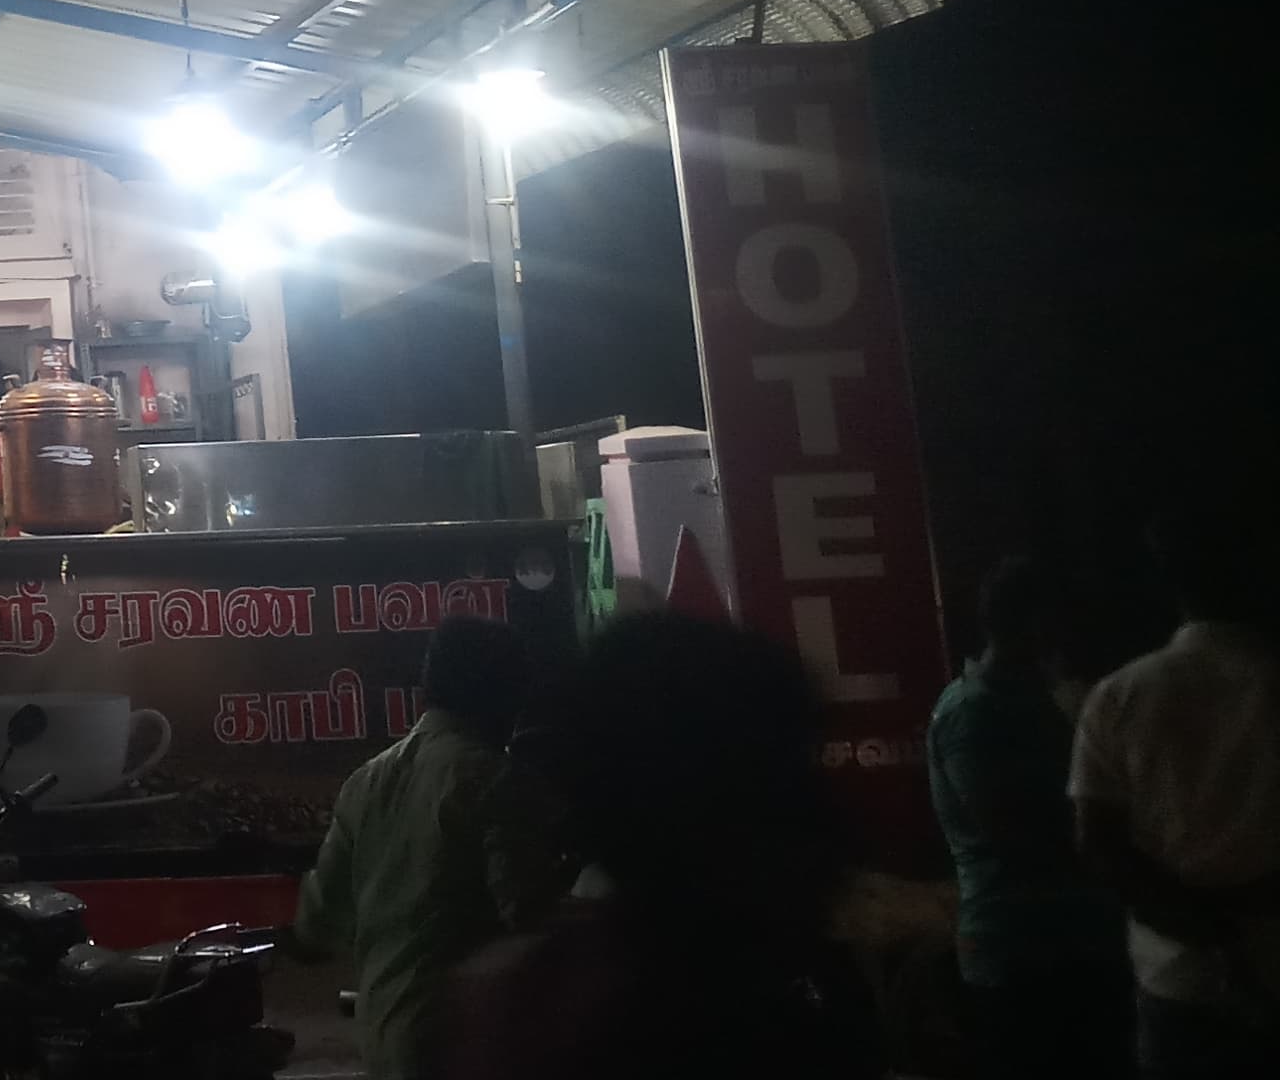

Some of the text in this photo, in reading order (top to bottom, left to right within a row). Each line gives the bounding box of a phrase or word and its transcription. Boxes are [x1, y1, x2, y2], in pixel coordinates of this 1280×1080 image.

[718, 103, 900, 702] HOTEL
[74, 582, 315, 648] சரவண
[214, 668, 366, 745] காபி
